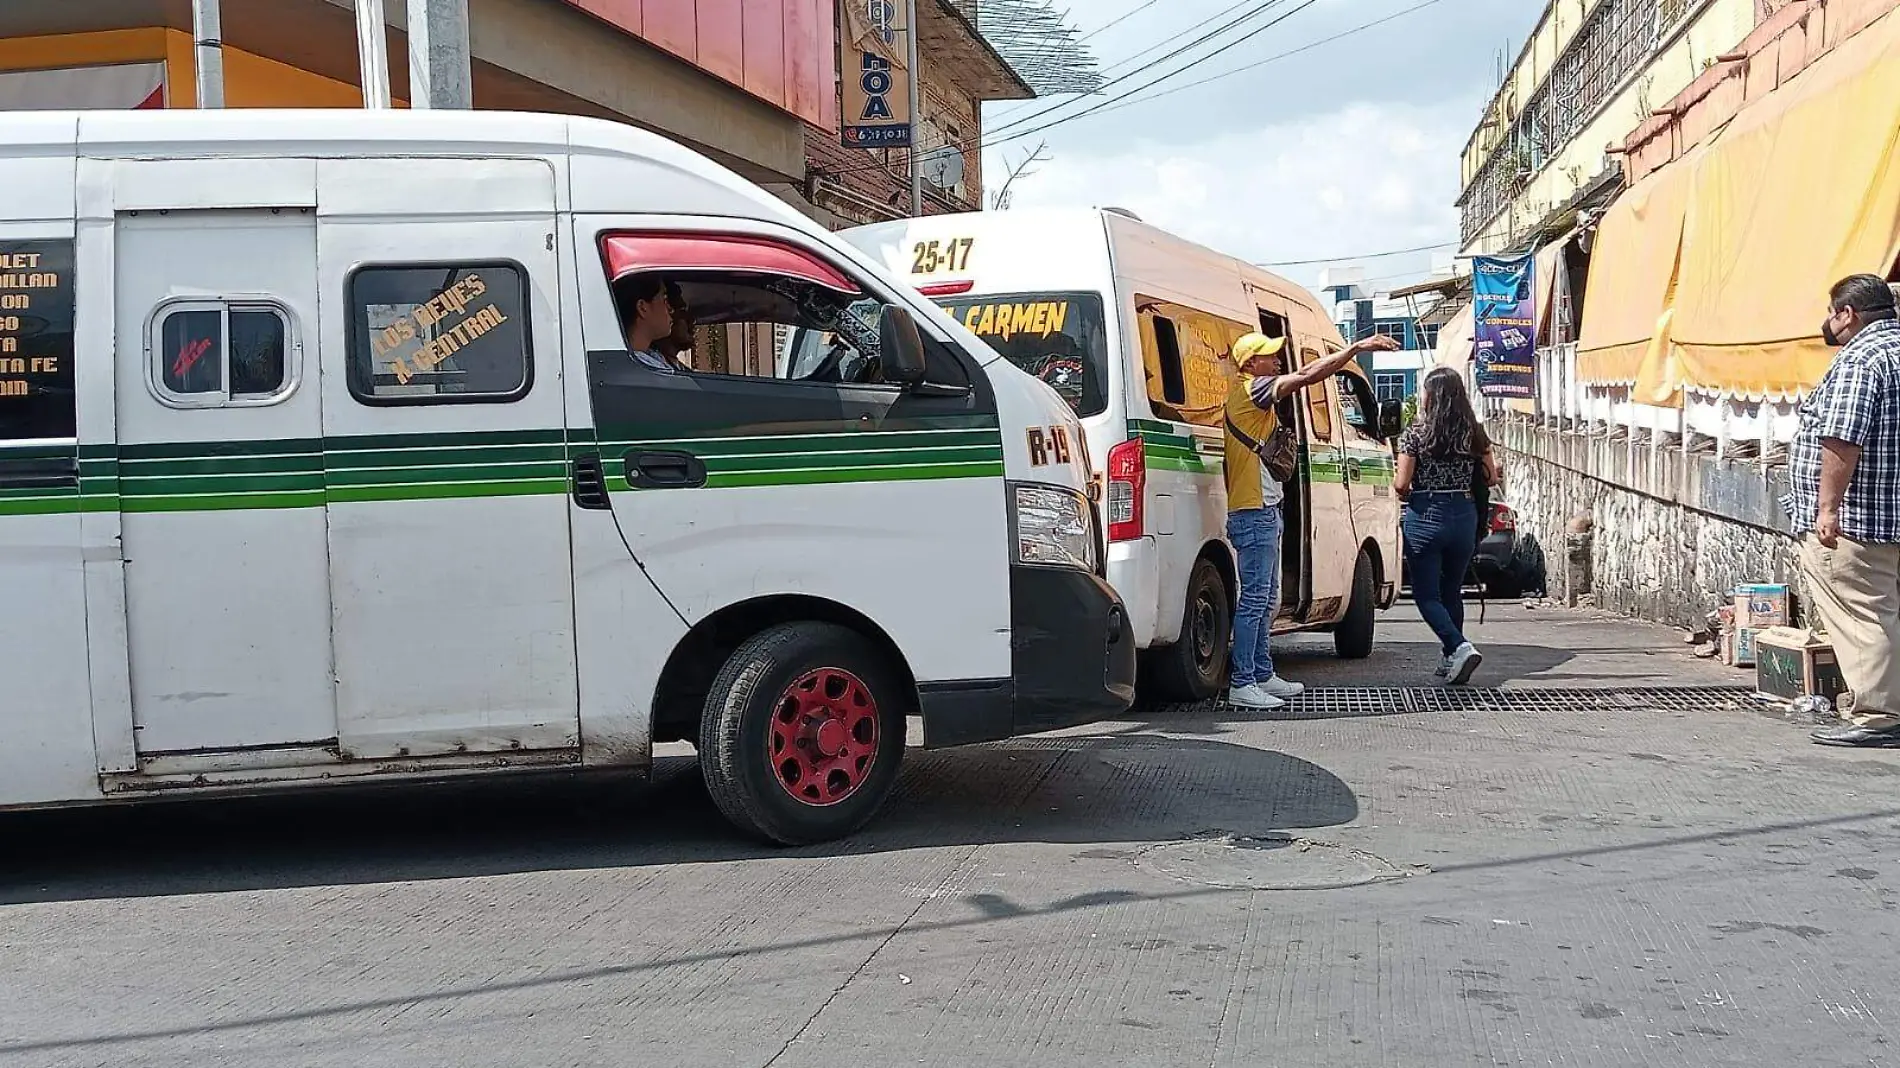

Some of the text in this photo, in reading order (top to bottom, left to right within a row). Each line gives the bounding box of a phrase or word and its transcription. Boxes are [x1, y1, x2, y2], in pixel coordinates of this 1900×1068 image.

[0, 252, 41, 269] LET
[911, 237, 974, 274] 25-17
[0, 272, 58, 288] ILLAN
[372, 317, 417, 356] LOS
[412, 303, 508, 371] CENTRAL
[964, 300, 1068, 343] CARMEN
[31, 356, 58, 373] FE
[1026, 425, 1071, 468] R-19
